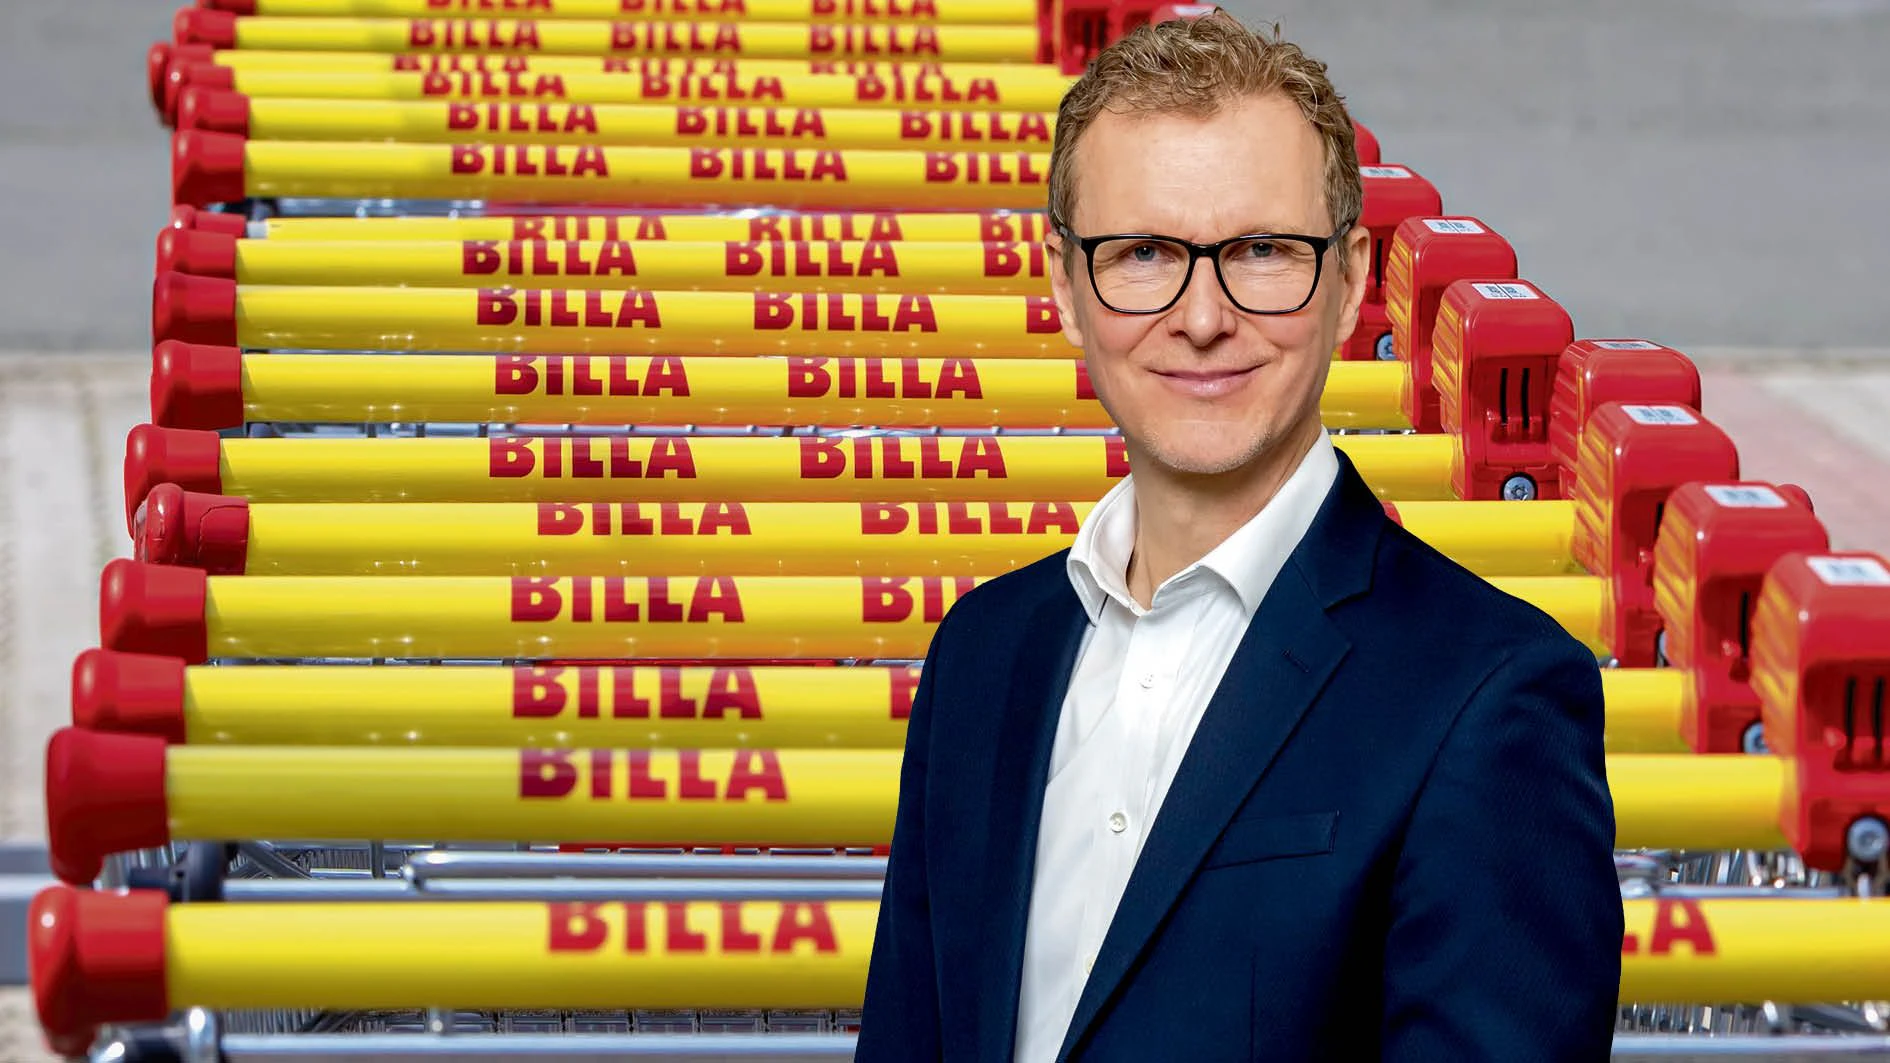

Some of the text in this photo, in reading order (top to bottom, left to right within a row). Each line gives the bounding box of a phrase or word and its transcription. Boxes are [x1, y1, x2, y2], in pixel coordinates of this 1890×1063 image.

[410, 20, 941, 56] BILLA BILLA BILLA
[423, 69, 1000, 103] BILLA BILLA BILLA
[448, 104, 1050, 142] BILLA BILLA BILLA
[451, 145, 1051, 185] BILLA BILLA BILL
[462, 240, 637, 276] BILLA
[725, 241, 900, 277] BILLA
[477, 288, 938, 333] BILLA BILLA
[494, 355, 984, 400] BILLA BILLA
[489, 437, 1007, 479] BILLA BILLA
[537, 502, 1080, 535] BILLA BILLA
[511, 576, 744, 623] BILLA
[512, 666, 763, 718] BILLA
[520, 749, 787, 800] BILLA
[548, 901, 838, 953] BILLA
